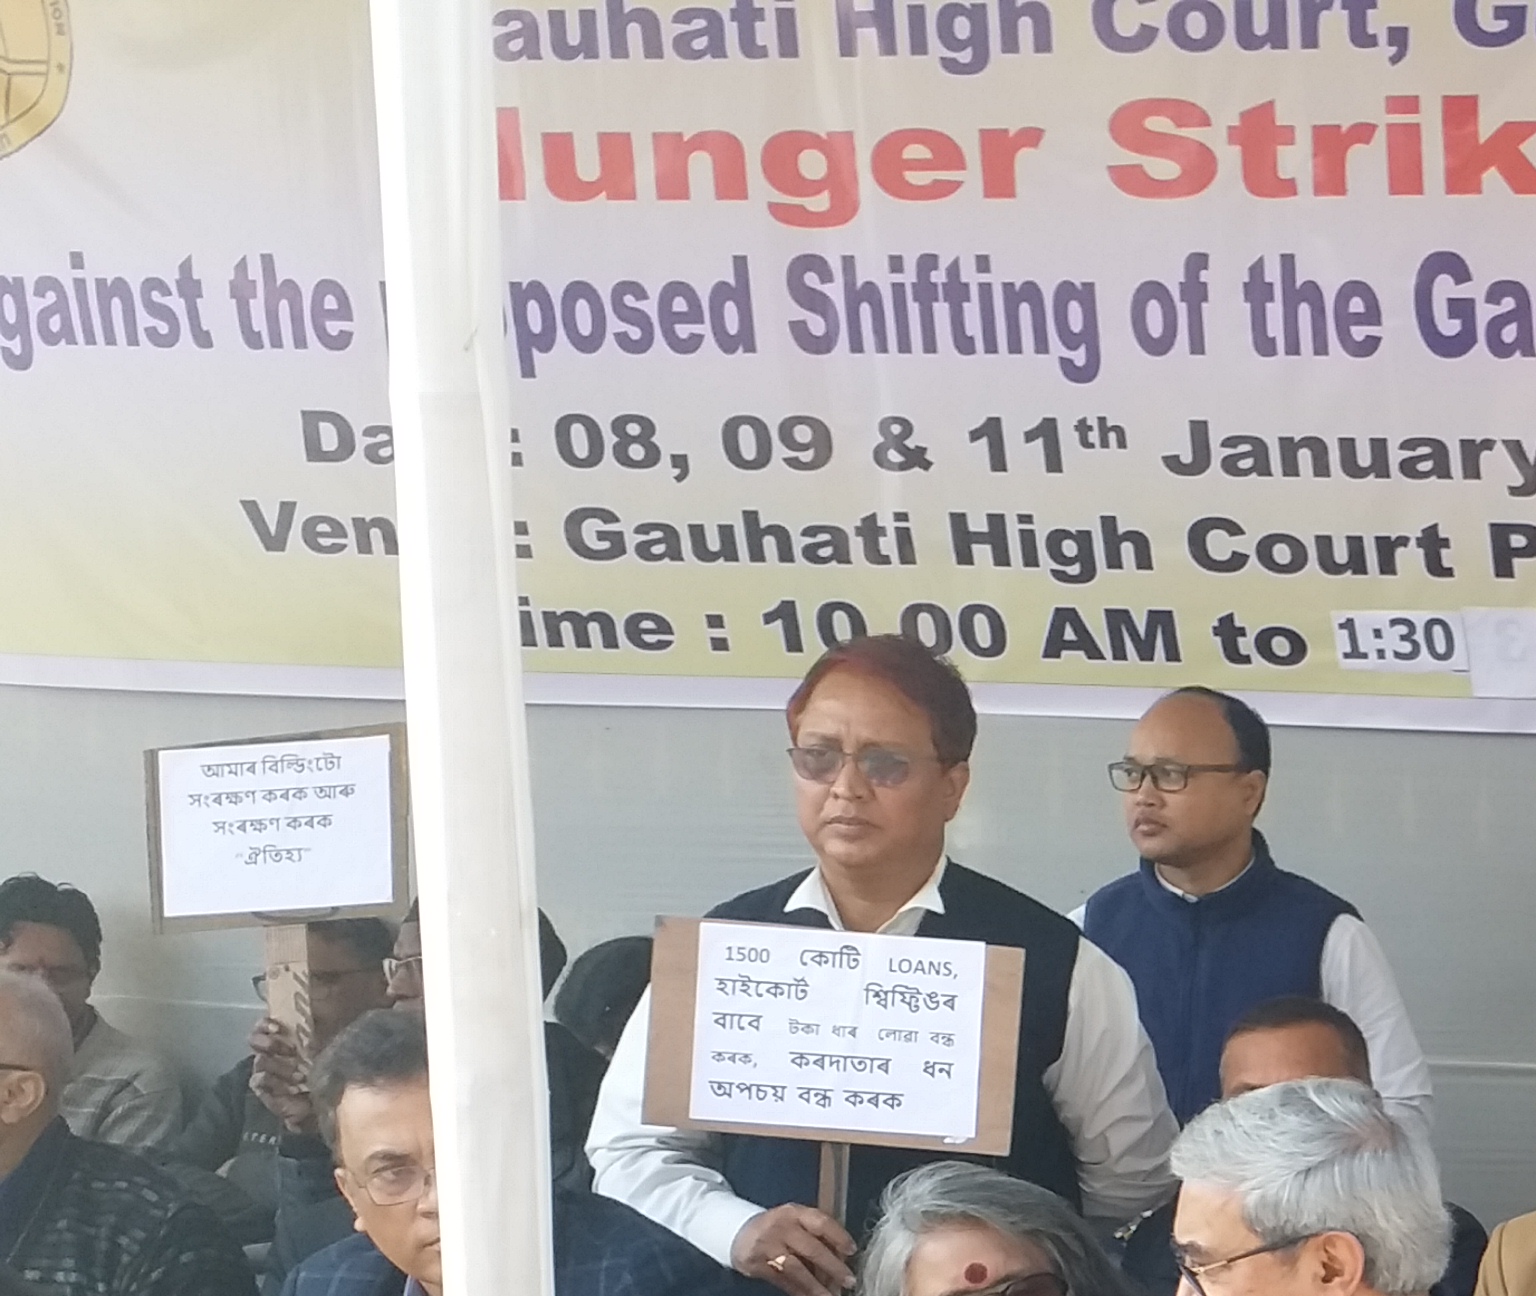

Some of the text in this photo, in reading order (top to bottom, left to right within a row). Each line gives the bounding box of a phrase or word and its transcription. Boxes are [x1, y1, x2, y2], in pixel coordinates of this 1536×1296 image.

[493, 0, 799, 61] auhati
[838, 0, 1053, 76] High
[1094, 0, 1409, 66] Court,
[229, 253, 354, 351] the
[380, 255, 758, 379] posed
[787, 253, 1101, 384] Shifting
[1130, 251, 1211, 357] of
[1243, 252, 1383, 358] the
[301, 410, 395, 463] Da
[555, 413, 690, 482] 08,
[721, 414, 834, 471] 09
[872, 416, 934, 473] &
[240, 500, 399, 556] Ven
[563, 507, 918, 567] Gauhati
[948, 511, 1154, 584] High
[1187, 517, 1455, 580] Court
[518, 596, 675, 651] ime
[1041, 606, 1183, 664] AM
[1212, 611, 1309, 667] to
[1336, 616, 1456, 663] 1:30
[724, 944, 959, 980] 1500 কোটি LOANS,
[922, 1060, 955, 1080] ধন
